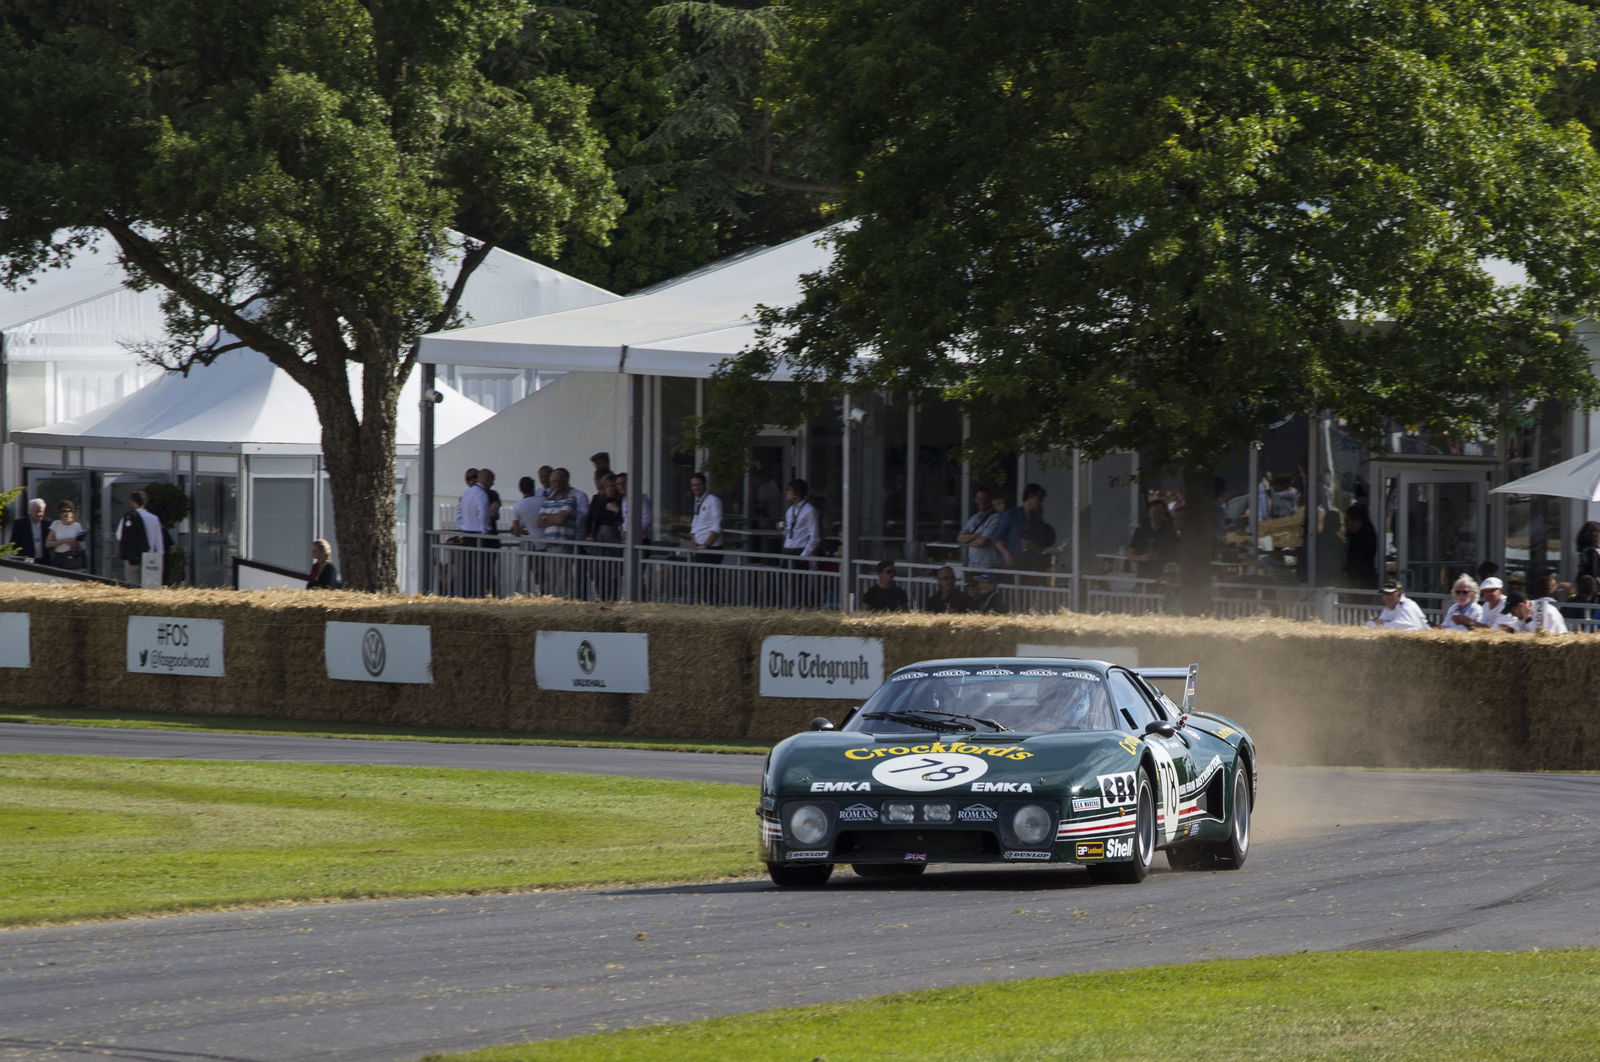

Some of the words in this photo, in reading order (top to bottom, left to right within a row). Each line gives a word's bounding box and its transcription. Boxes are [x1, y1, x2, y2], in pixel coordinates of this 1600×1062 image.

[157, 623, 189, 646] #FOS
[151, 650, 210, 671] @fosgoodwood
[769, 650, 795, 678] The
[798, 650, 870, 685] Telegraph
[891, 672, 929, 682] ROMANS
[932, 669, 971, 677] ROMANS
[1062, 672, 1100, 682] ROMANS
[844, 741, 1035, 761] Crockford's
[888, 758, 970, 782] 78
[810, 781, 871, 793] EMKA
[970, 782, 1033, 793] EMKA
[1103, 774, 1136, 804] CBS
[1160, 761, 1177, 816] 78
[839, 810, 878, 820] ROMANS
[958, 810, 998, 820] ROMANS
[1106, 838, 1134, 858] Shell
